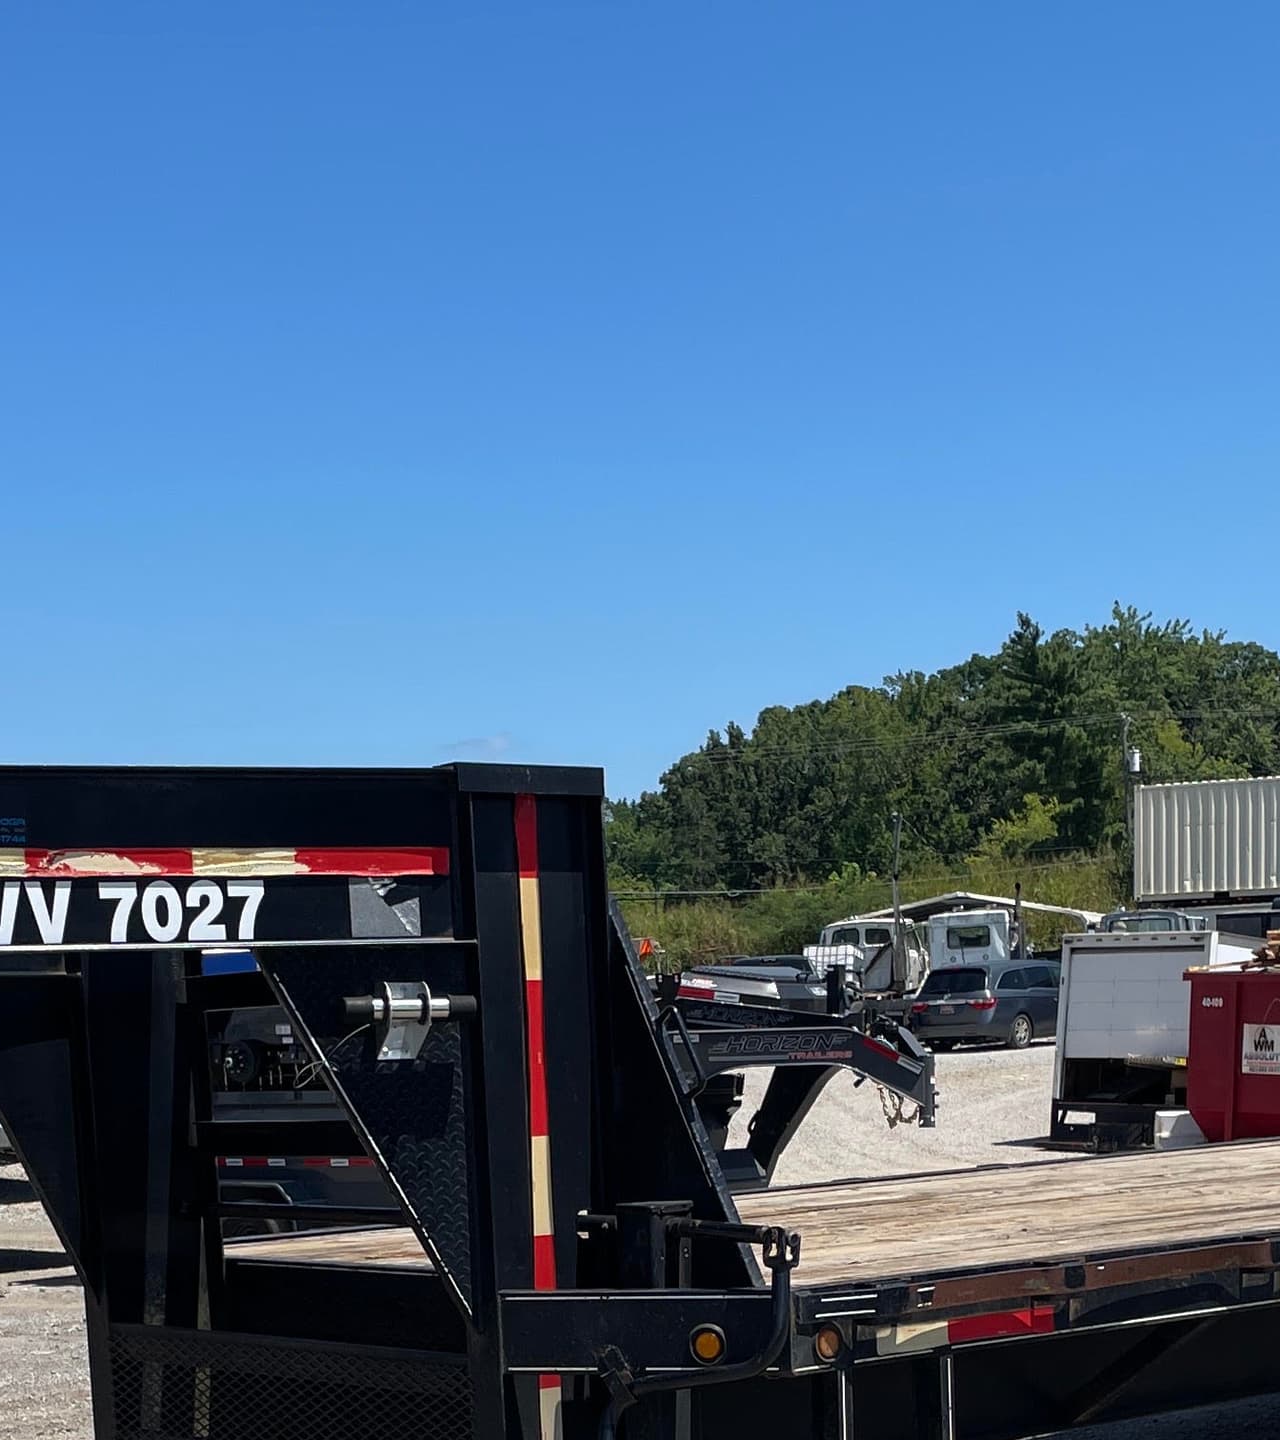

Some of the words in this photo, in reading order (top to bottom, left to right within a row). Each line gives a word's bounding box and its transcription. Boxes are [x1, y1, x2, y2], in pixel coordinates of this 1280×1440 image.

[98, 879, 265, 943] 7027
[725, 1033, 837, 1053] HORIZON
[788, 1051, 852, 1060] TRAILERS
